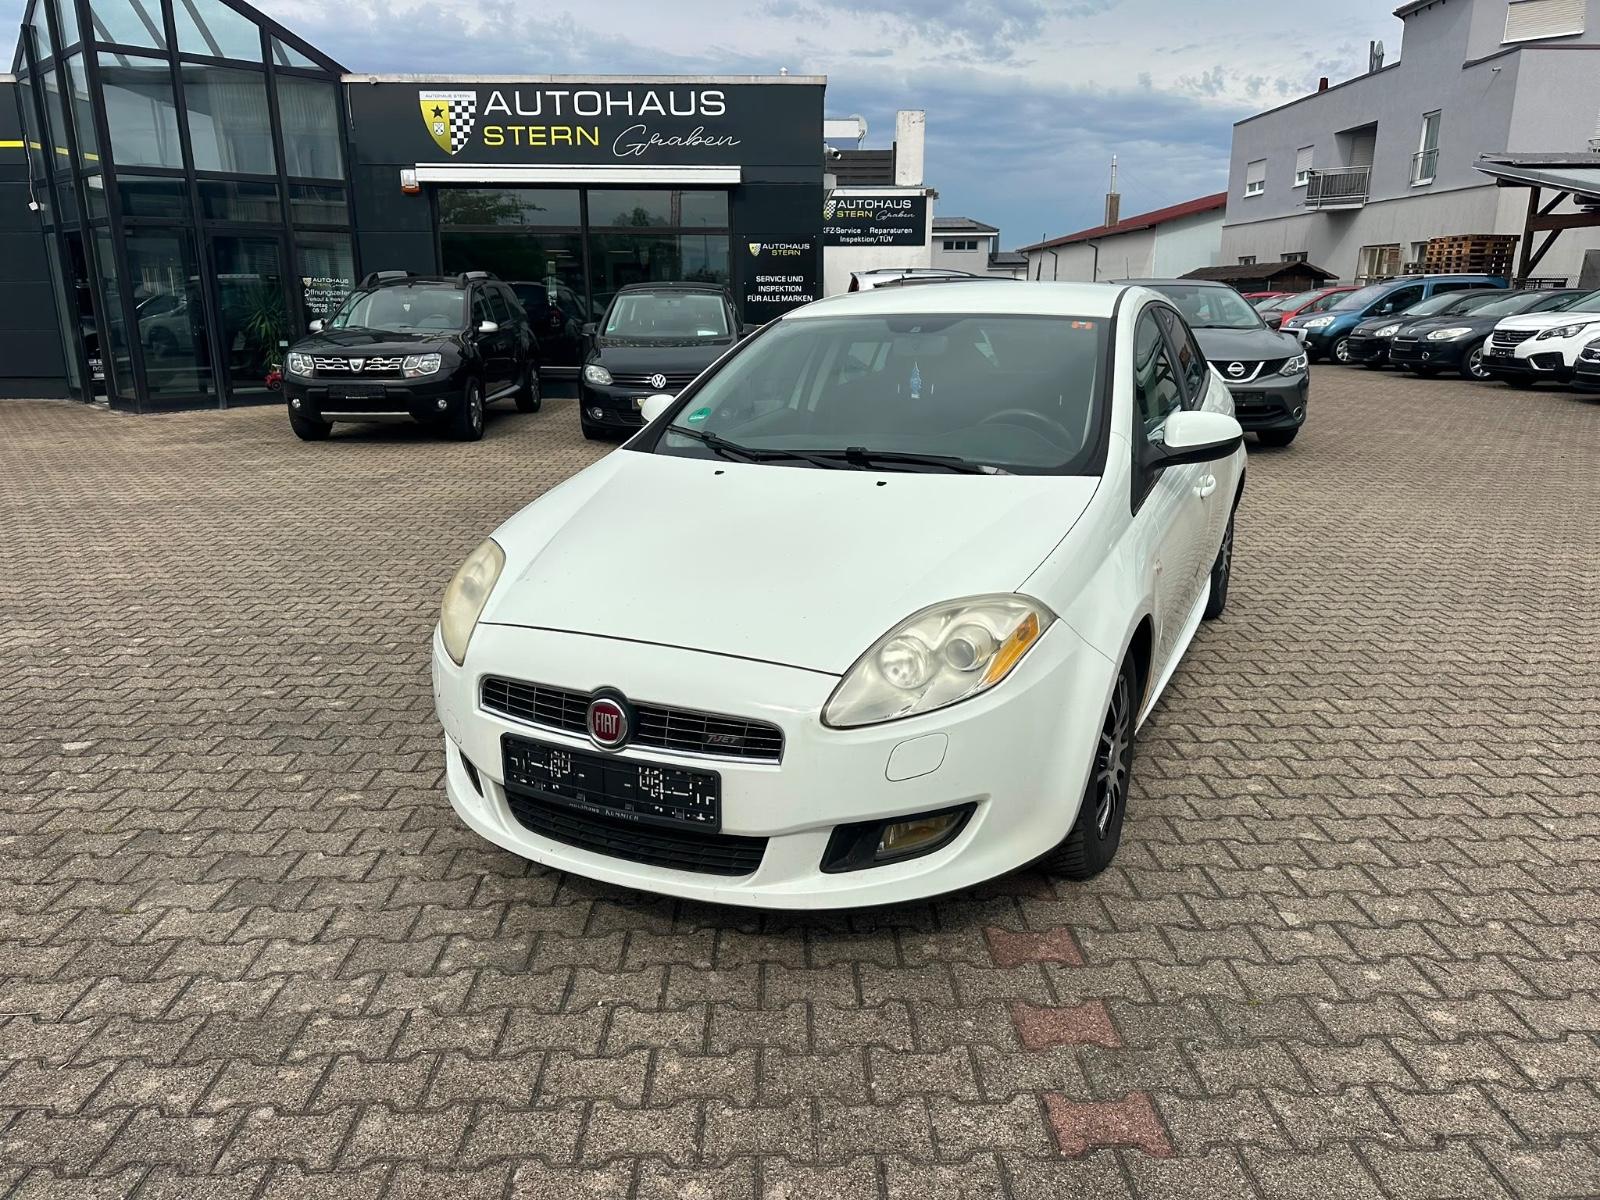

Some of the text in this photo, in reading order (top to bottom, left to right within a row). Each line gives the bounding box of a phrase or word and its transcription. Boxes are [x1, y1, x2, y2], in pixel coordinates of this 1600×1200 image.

[483, 90, 726, 116] AUTOHAUS
[483, 123, 742, 157] STERN Graben
[837, 199, 912, 209] AUTOHAUS
[836, 209, 916, 221] STERN Graben
[869, 226, 913, 235] Reparaturen
[839, 234, 894, 244] Inspektion/TÜV
[755, 275, 804, 283] SERVICE UND
[757, 285, 802, 293] INSPEKTION
[746, 293, 813, 302] FÜR ALLE MARKEN
[595, 711, 618, 734] FIAT
